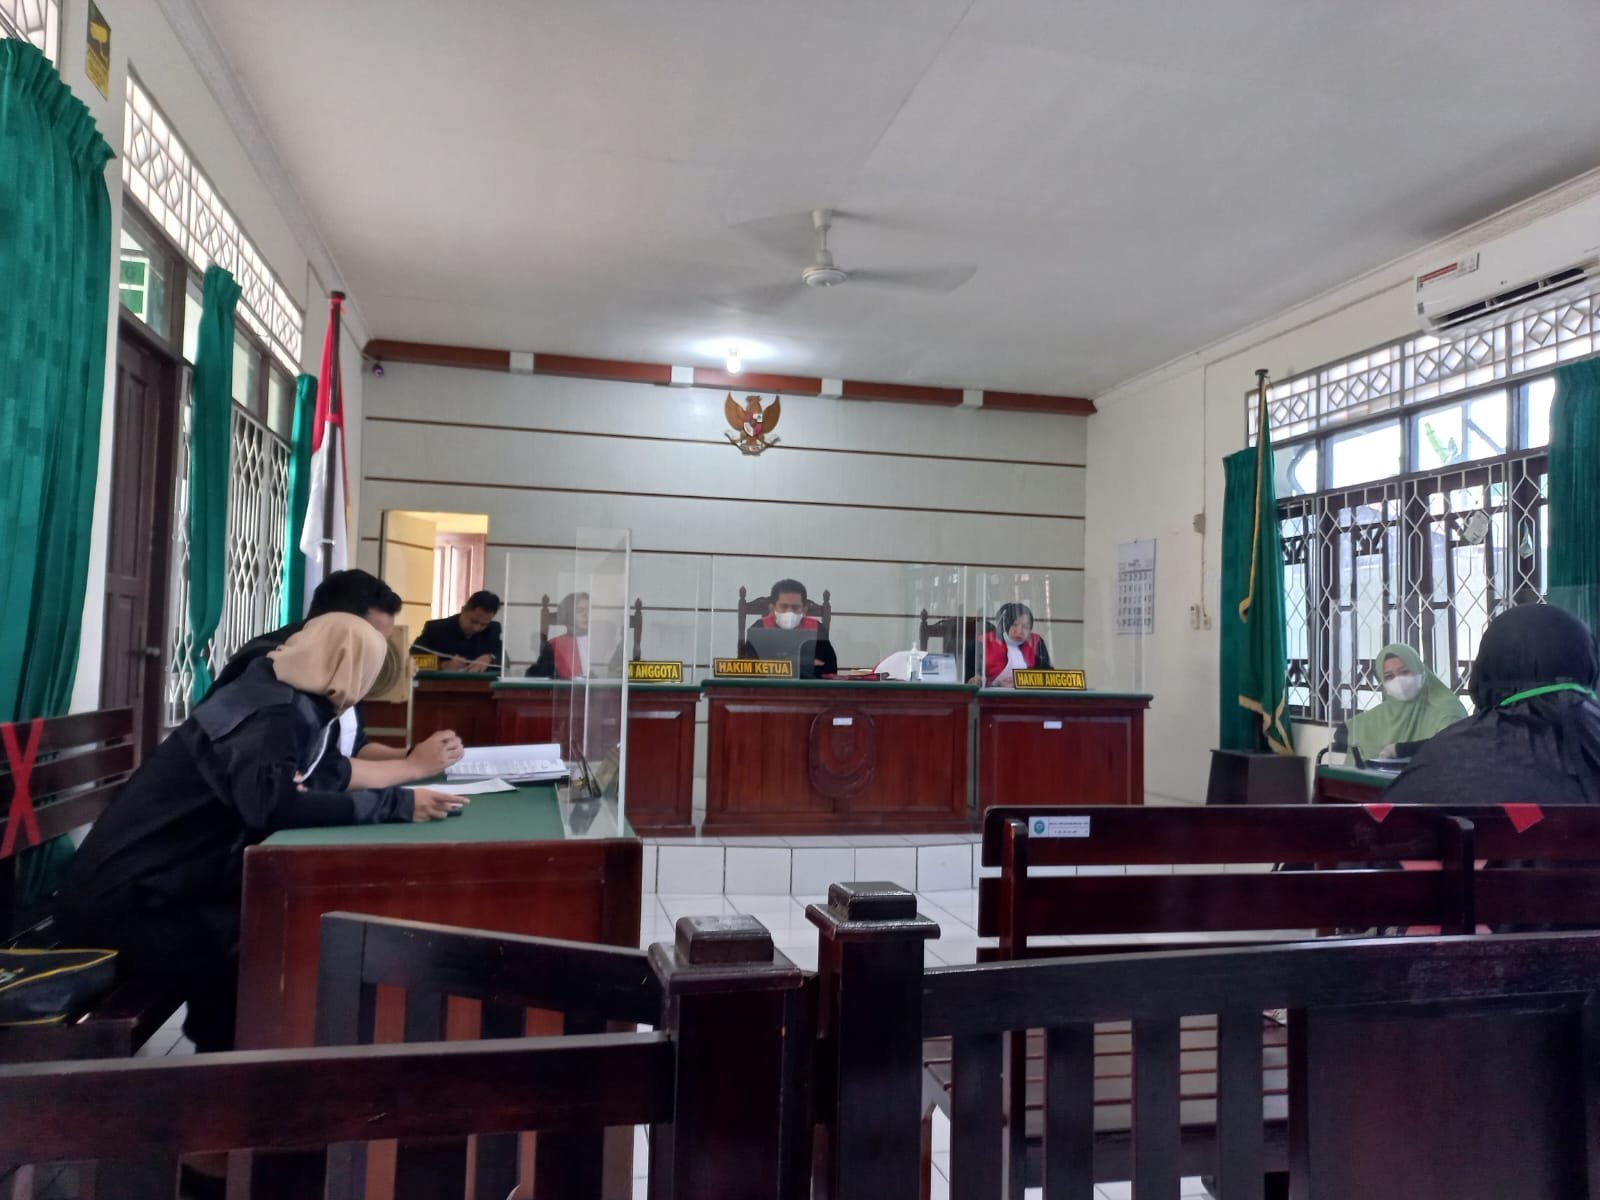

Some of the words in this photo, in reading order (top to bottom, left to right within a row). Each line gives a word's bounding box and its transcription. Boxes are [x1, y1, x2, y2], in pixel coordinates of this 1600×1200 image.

[635, 664, 678, 679] ANGGOTA
[718, 661, 752, 673] HAKIM
[754, 662, 789, 675] KETUA
[1017, 672, 1044, 686] HAKIM
[1045, 673, 1082, 687] ANGGOTA
